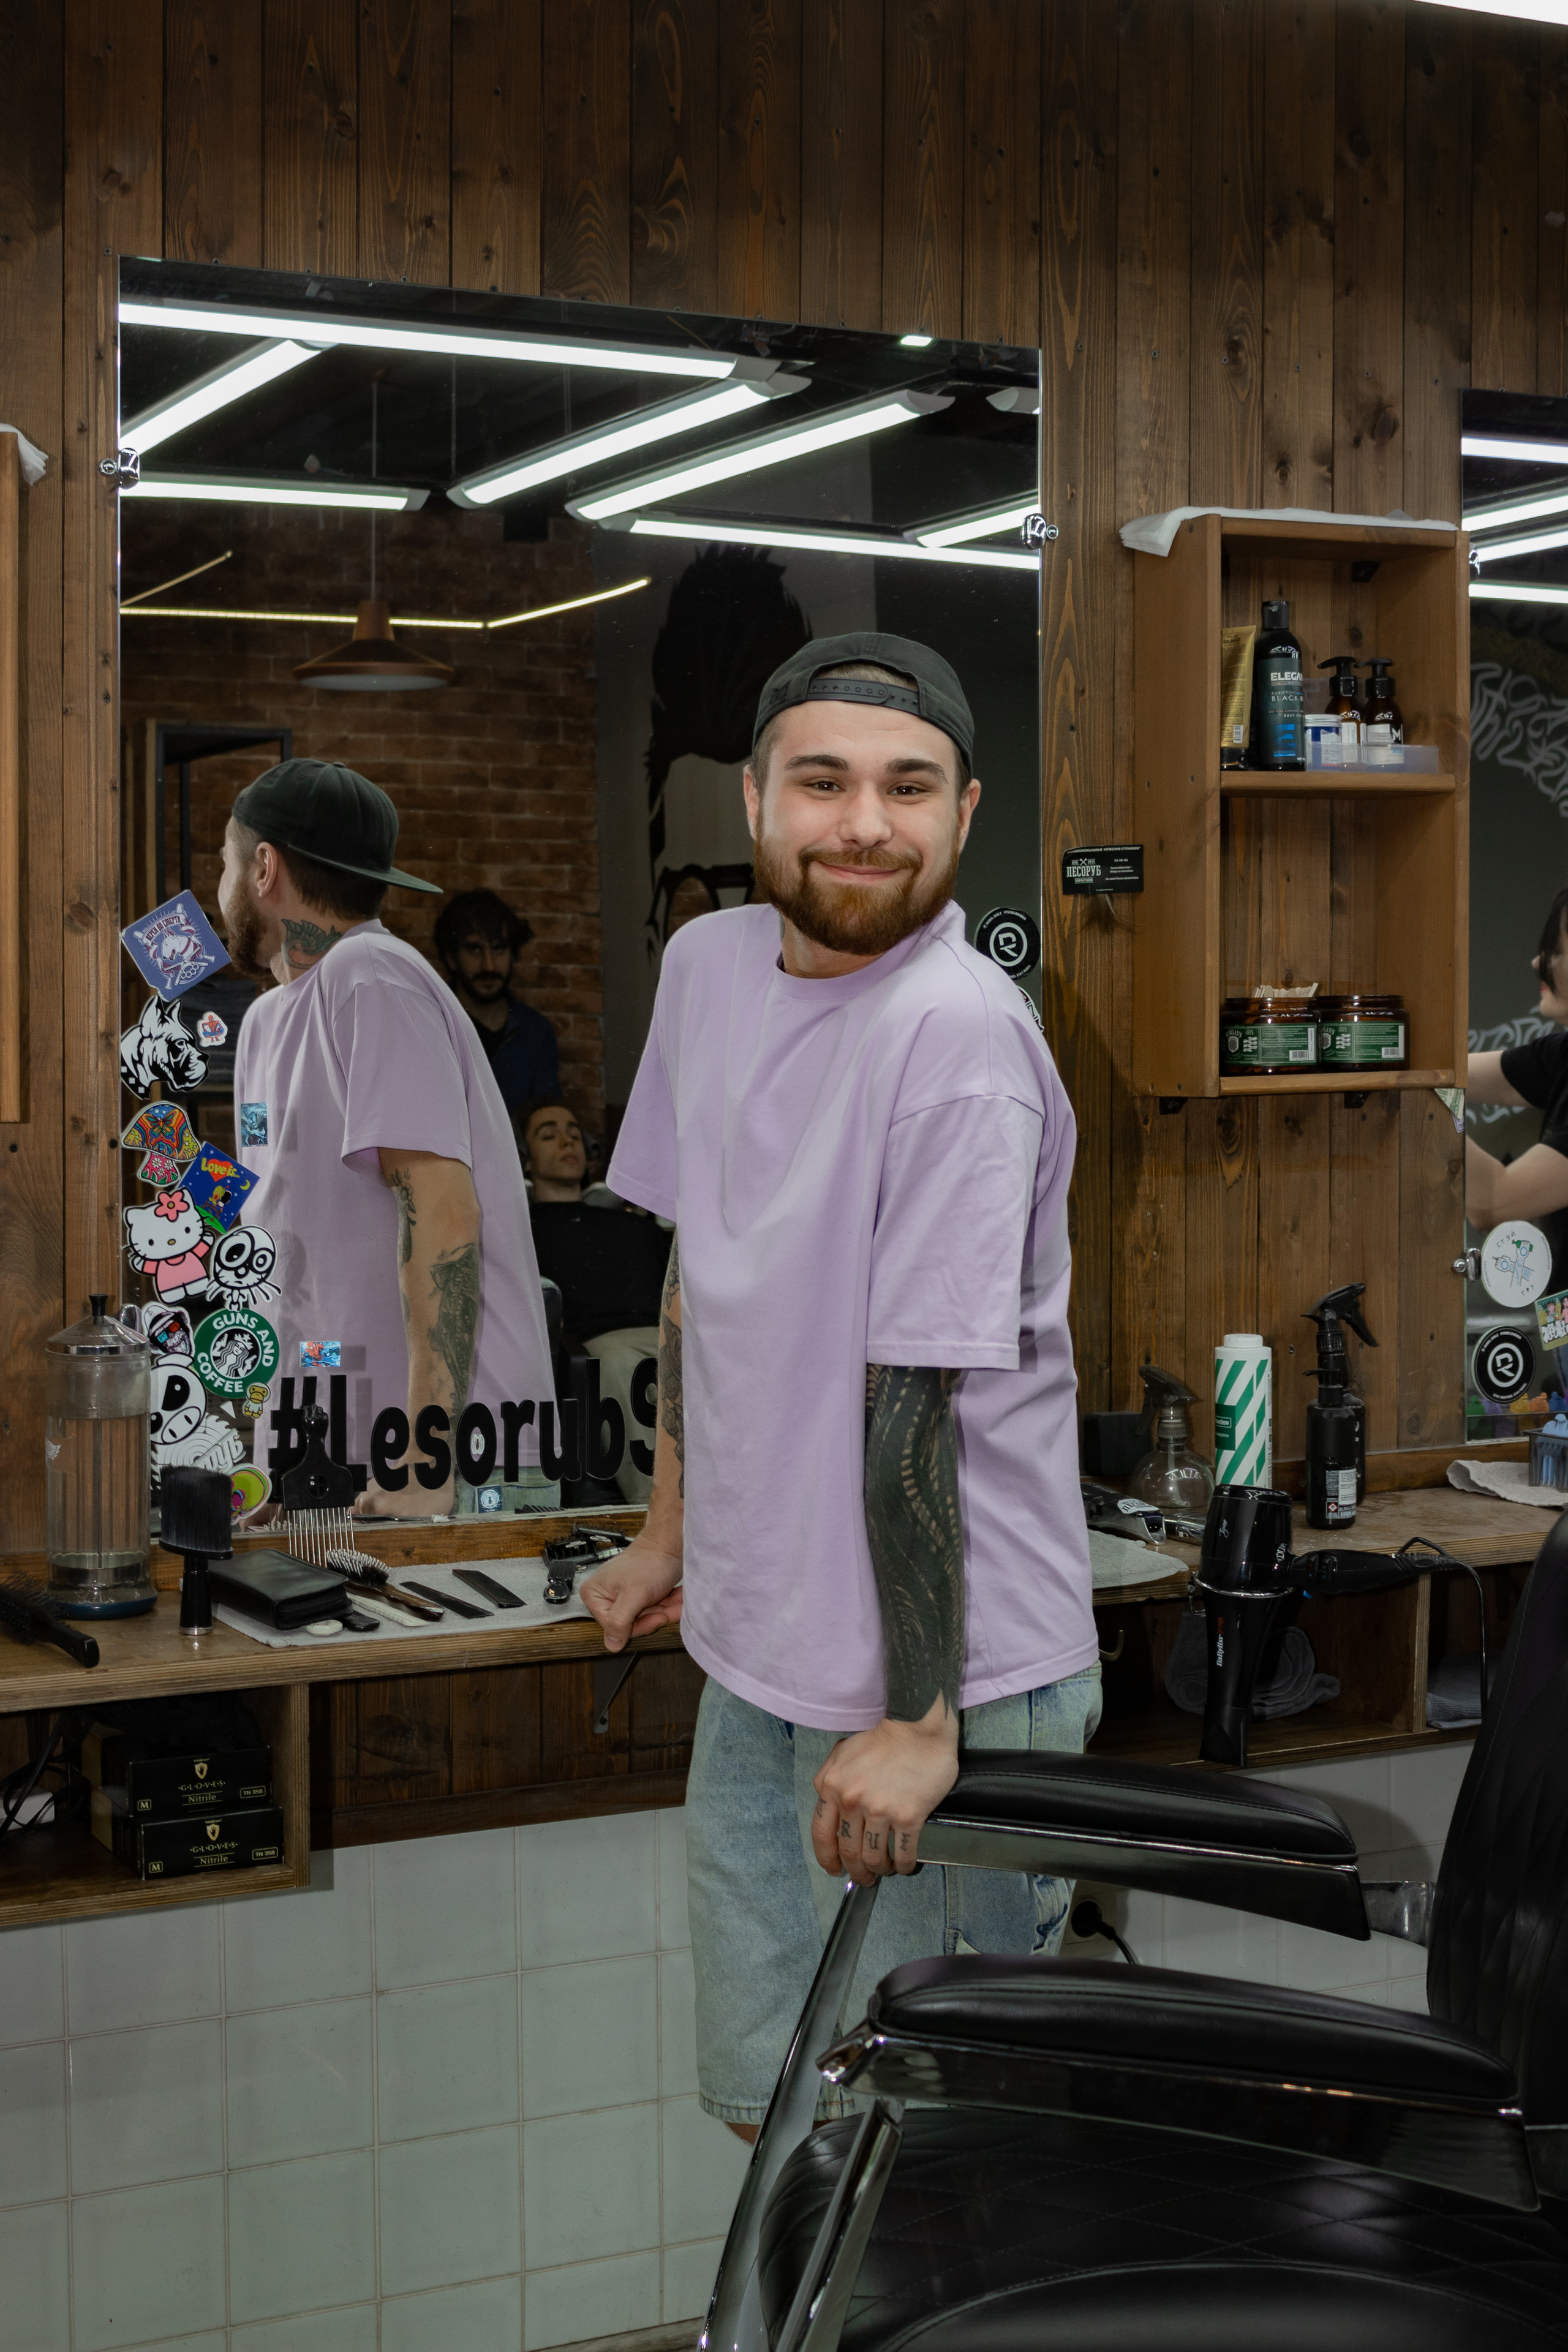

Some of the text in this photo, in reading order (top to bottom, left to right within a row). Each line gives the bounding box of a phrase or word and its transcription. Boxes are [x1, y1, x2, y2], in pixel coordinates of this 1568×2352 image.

[1066, 865, 1101, 878] ЛЕСОРУБ
[162, 916, 181, 927] СМЕРТИ
[201, 1157, 227, 1177] Love
[1496, 1230, 1516, 1248] СТЭЙ
[212, 1313, 275, 1366] GUNS AND
[197, 1352, 244, 1393] COFFEE
[188, 1794, 216, 1803] Nitrile
[140, 1801, 149, 1809] M
[200, 1855, 228, 1865] Nitrile
[152, 1863, 161, 1872] M
